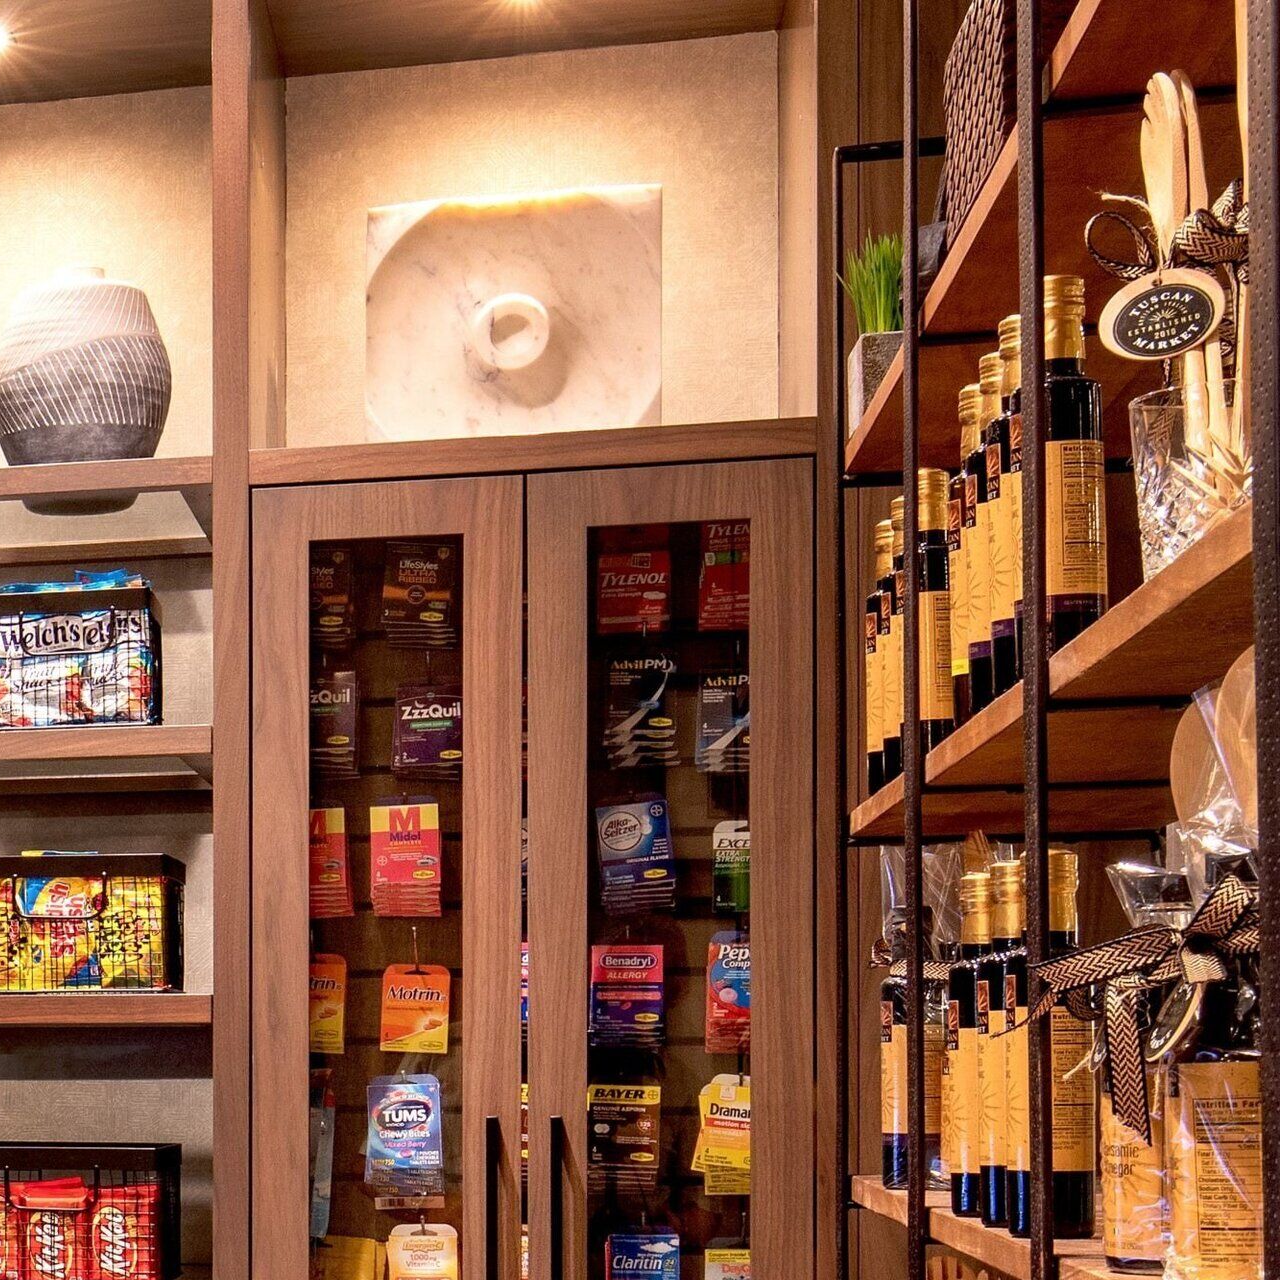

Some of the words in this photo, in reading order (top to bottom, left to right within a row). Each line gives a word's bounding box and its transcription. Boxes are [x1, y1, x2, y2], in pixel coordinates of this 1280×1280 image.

[1129, 292, 1193, 317] TUSCAN
[1128, 313, 1201, 337] ESTABLISHED
[1133, 324, 1199, 349] MARKET
[1154, 328, 1176, 339] 2010
[600, 572, 667, 586] TYLENOL
[1, 618, 79, 652] Welch's
[611, 659, 643, 669] Advil
[645, 659, 666, 669] PM
[704, 676, 737, 686] Advil
[401, 700, 461, 720] ZzzQuil
[607, 818, 632, 831] Alka-
[389, 831, 421, 842] Midol
[603, 824, 639, 840] Seltzer
[605, 956, 651, 968] Benadryl
[388, 986, 441, 1001] Motrin
[594, 1088, 645, 1099] BAYER
[383, 1110, 426, 1122] TUMS
[379, 1130, 407, 1139] Chewy
[409, 1130, 430, 1138] Bites
[613, 1255, 662, 1270] Claritin
